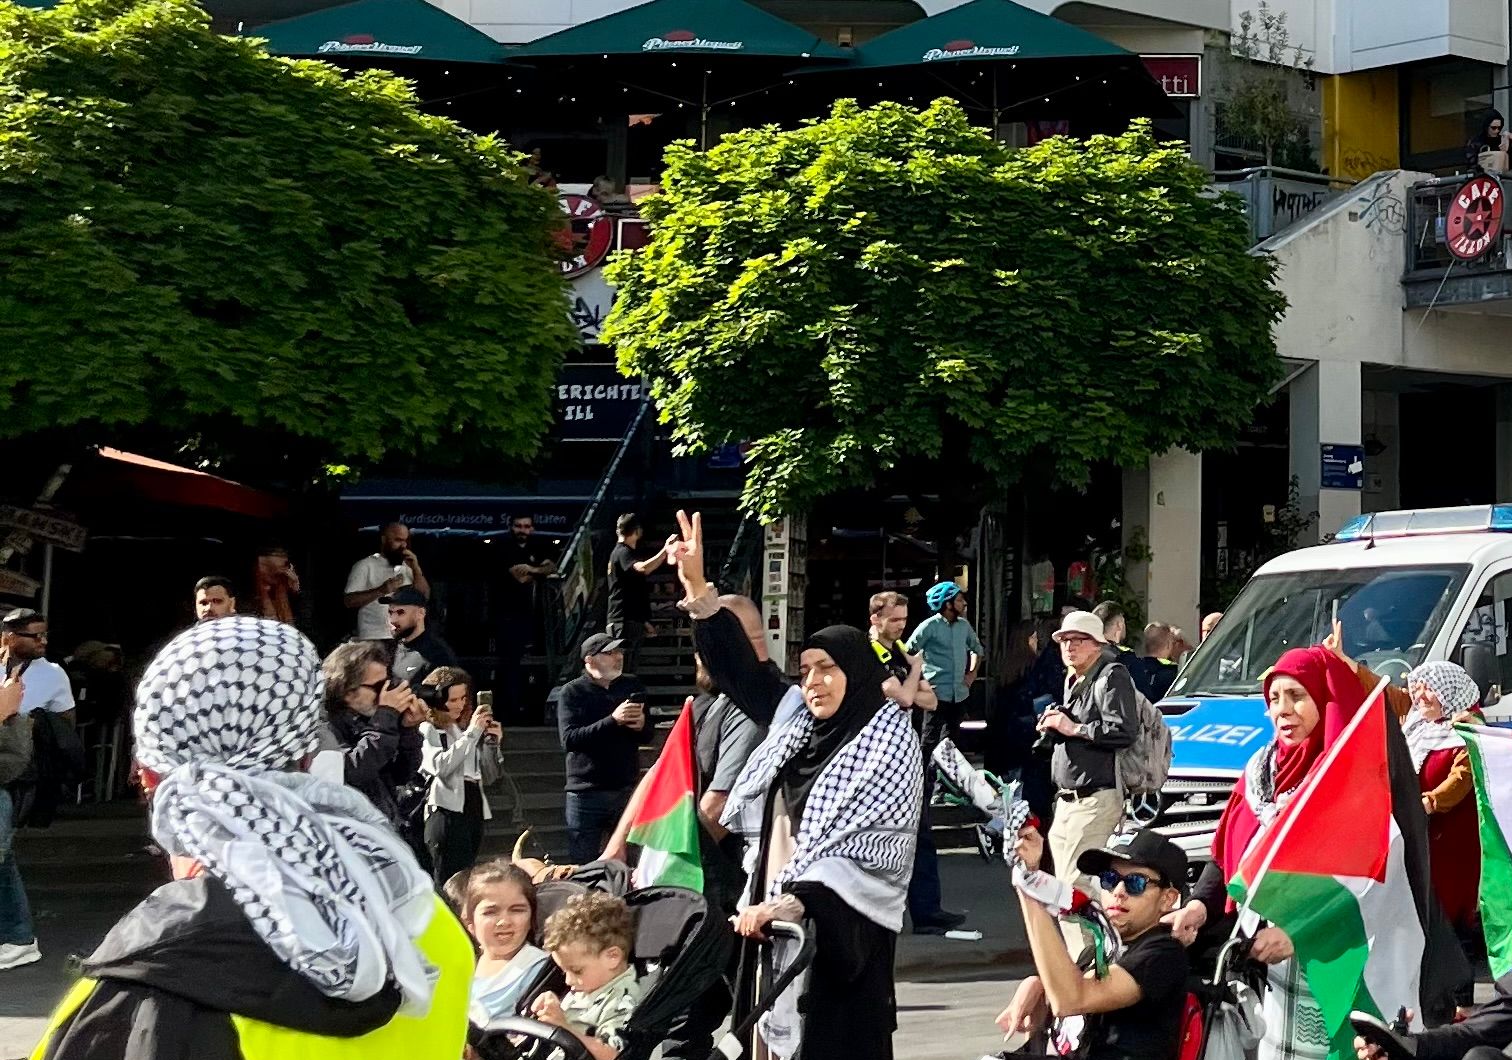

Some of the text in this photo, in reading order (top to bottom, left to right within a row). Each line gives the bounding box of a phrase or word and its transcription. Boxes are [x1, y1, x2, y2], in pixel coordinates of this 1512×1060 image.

[1162, 74, 1188, 94] tti
[557, 384, 641, 400] ERICHTE
[564, 404, 594, 421] ILL
[1169, 724, 1264, 746] LIZEI
